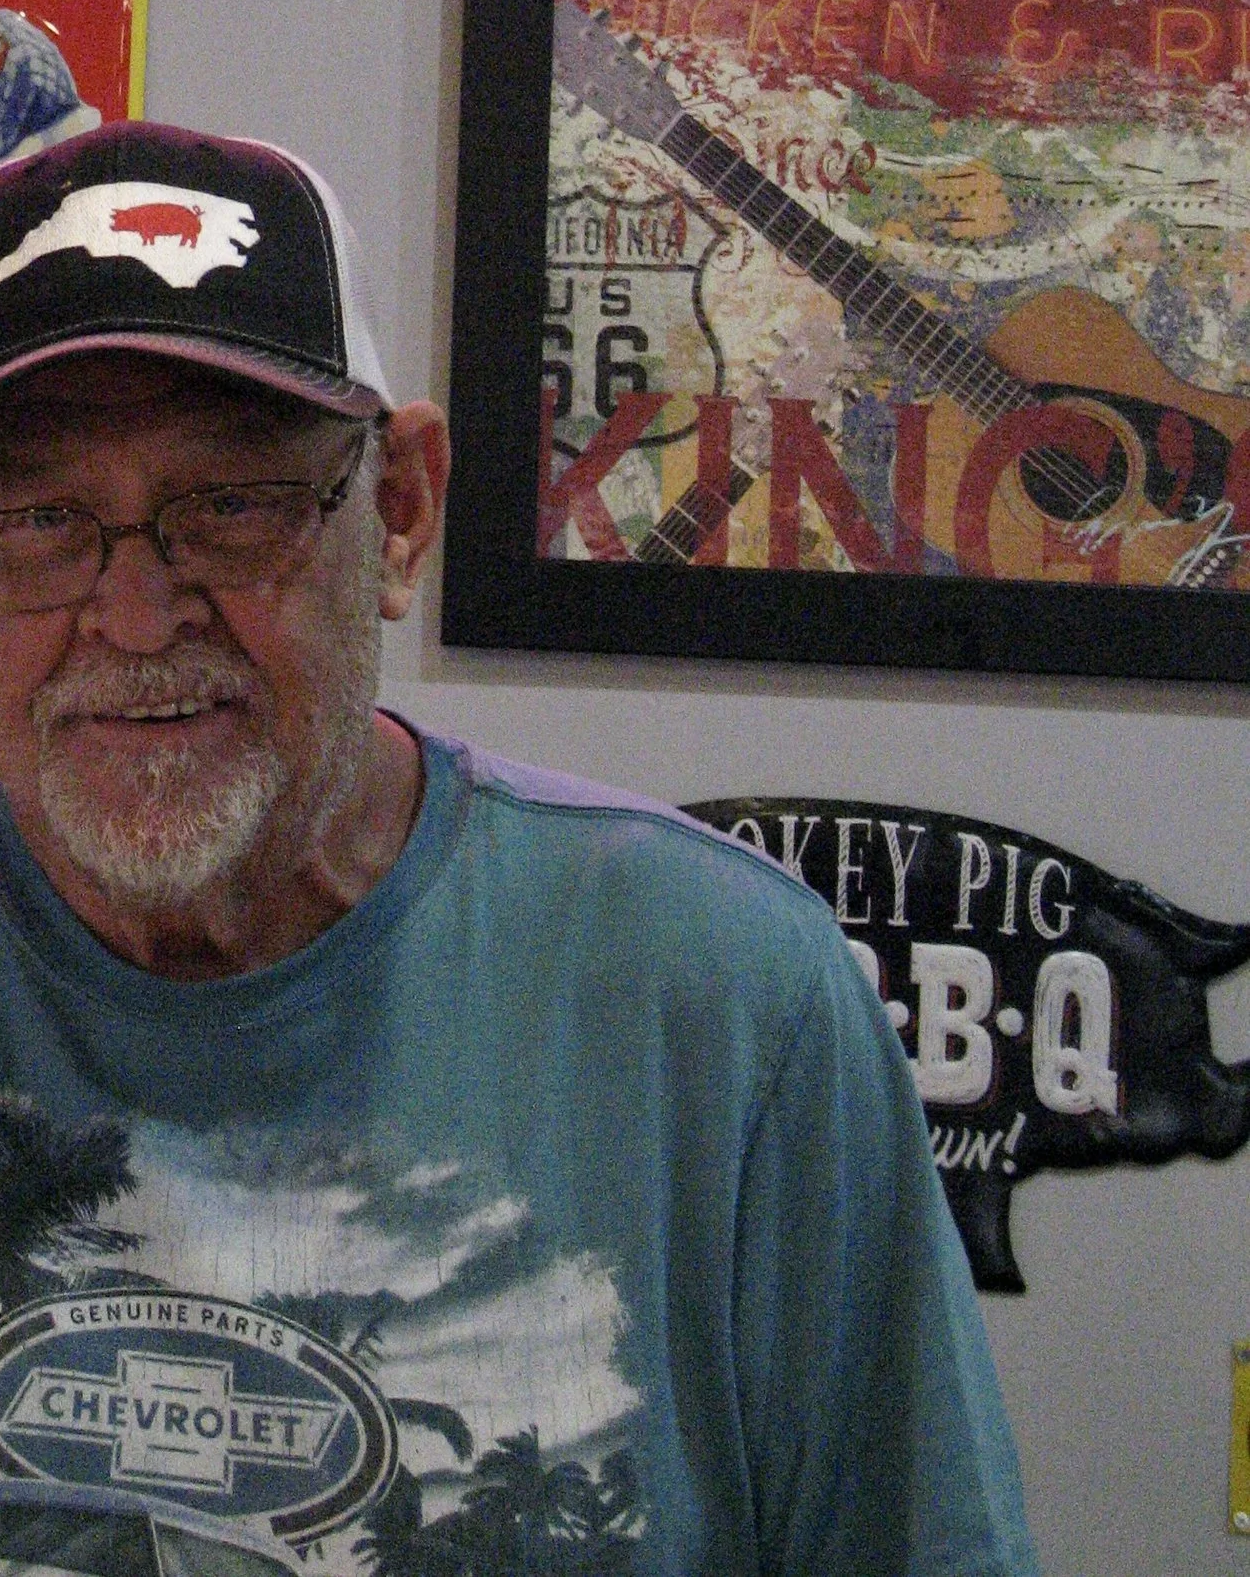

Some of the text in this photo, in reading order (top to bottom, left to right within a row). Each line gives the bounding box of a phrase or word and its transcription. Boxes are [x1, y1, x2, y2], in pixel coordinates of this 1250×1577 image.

[952, 833, 1076, 940] PIG
[70, 1301, 284, 1348] GENUINE PARTS
[40, 1383, 302, 1448] CHEVROLET
